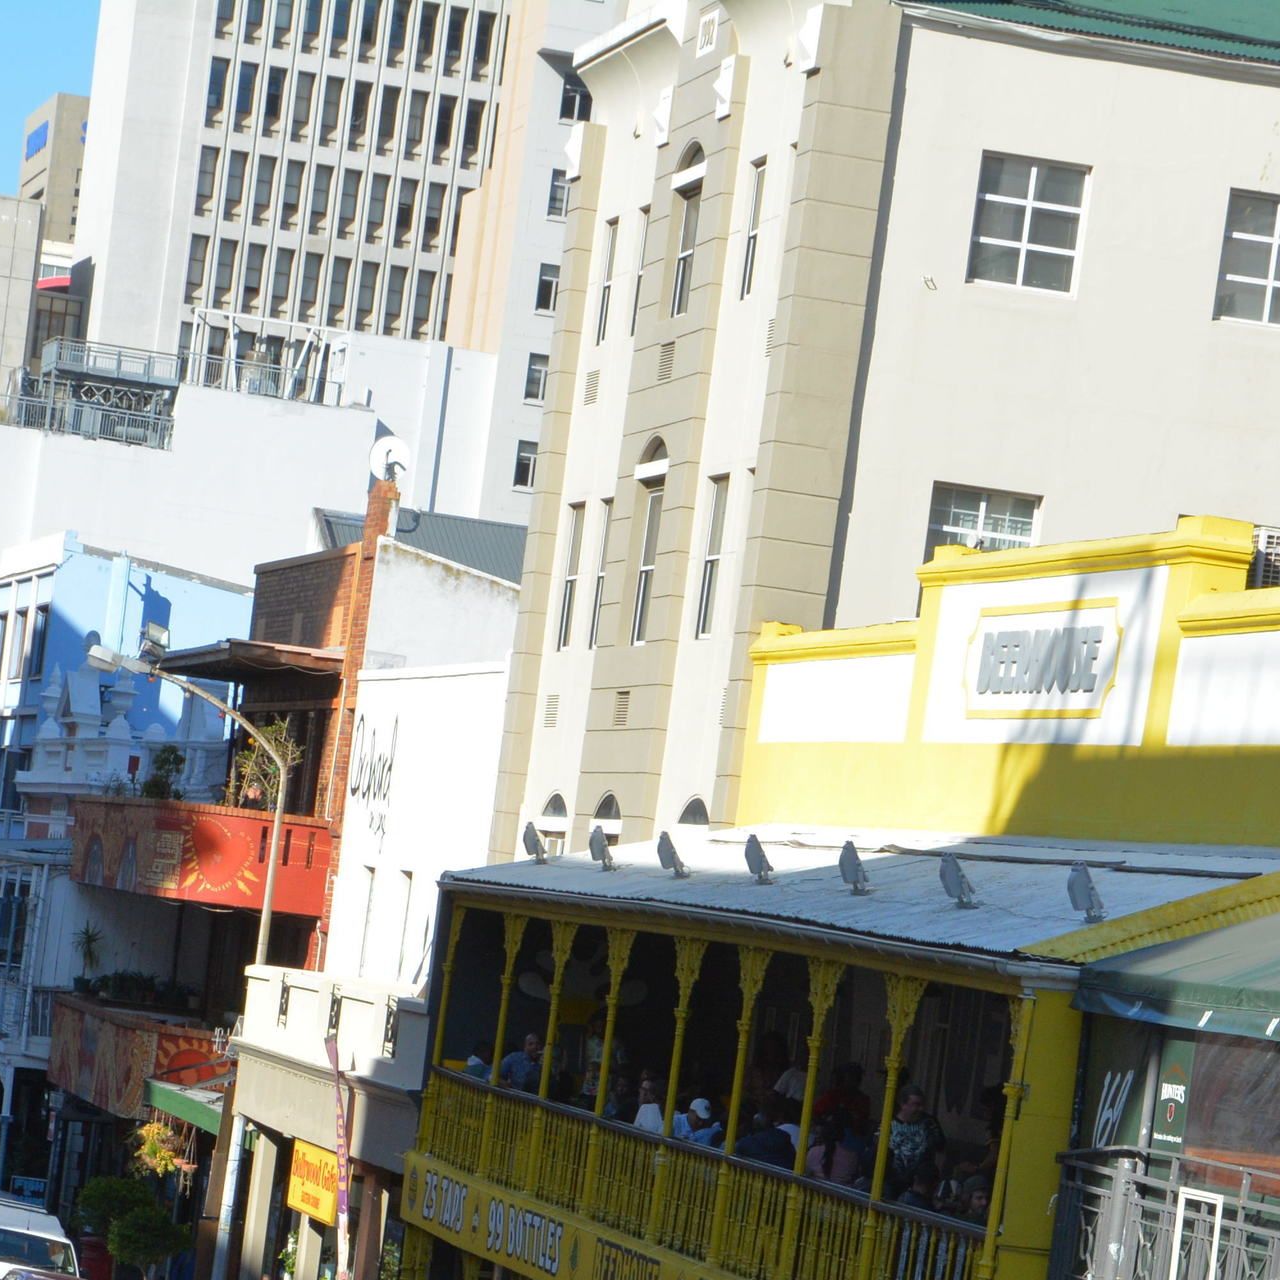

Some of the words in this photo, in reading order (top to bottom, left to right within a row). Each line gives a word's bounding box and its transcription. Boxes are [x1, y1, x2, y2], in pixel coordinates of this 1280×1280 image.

[1091, 1069, 1135, 1149] 169
[422, 1169, 439, 1220] 25
[438, 1175, 468, 1233] TAPS
[487, 1197, 504, 1251] 99
[506, 1204, 564, 1277] BOTTLES
